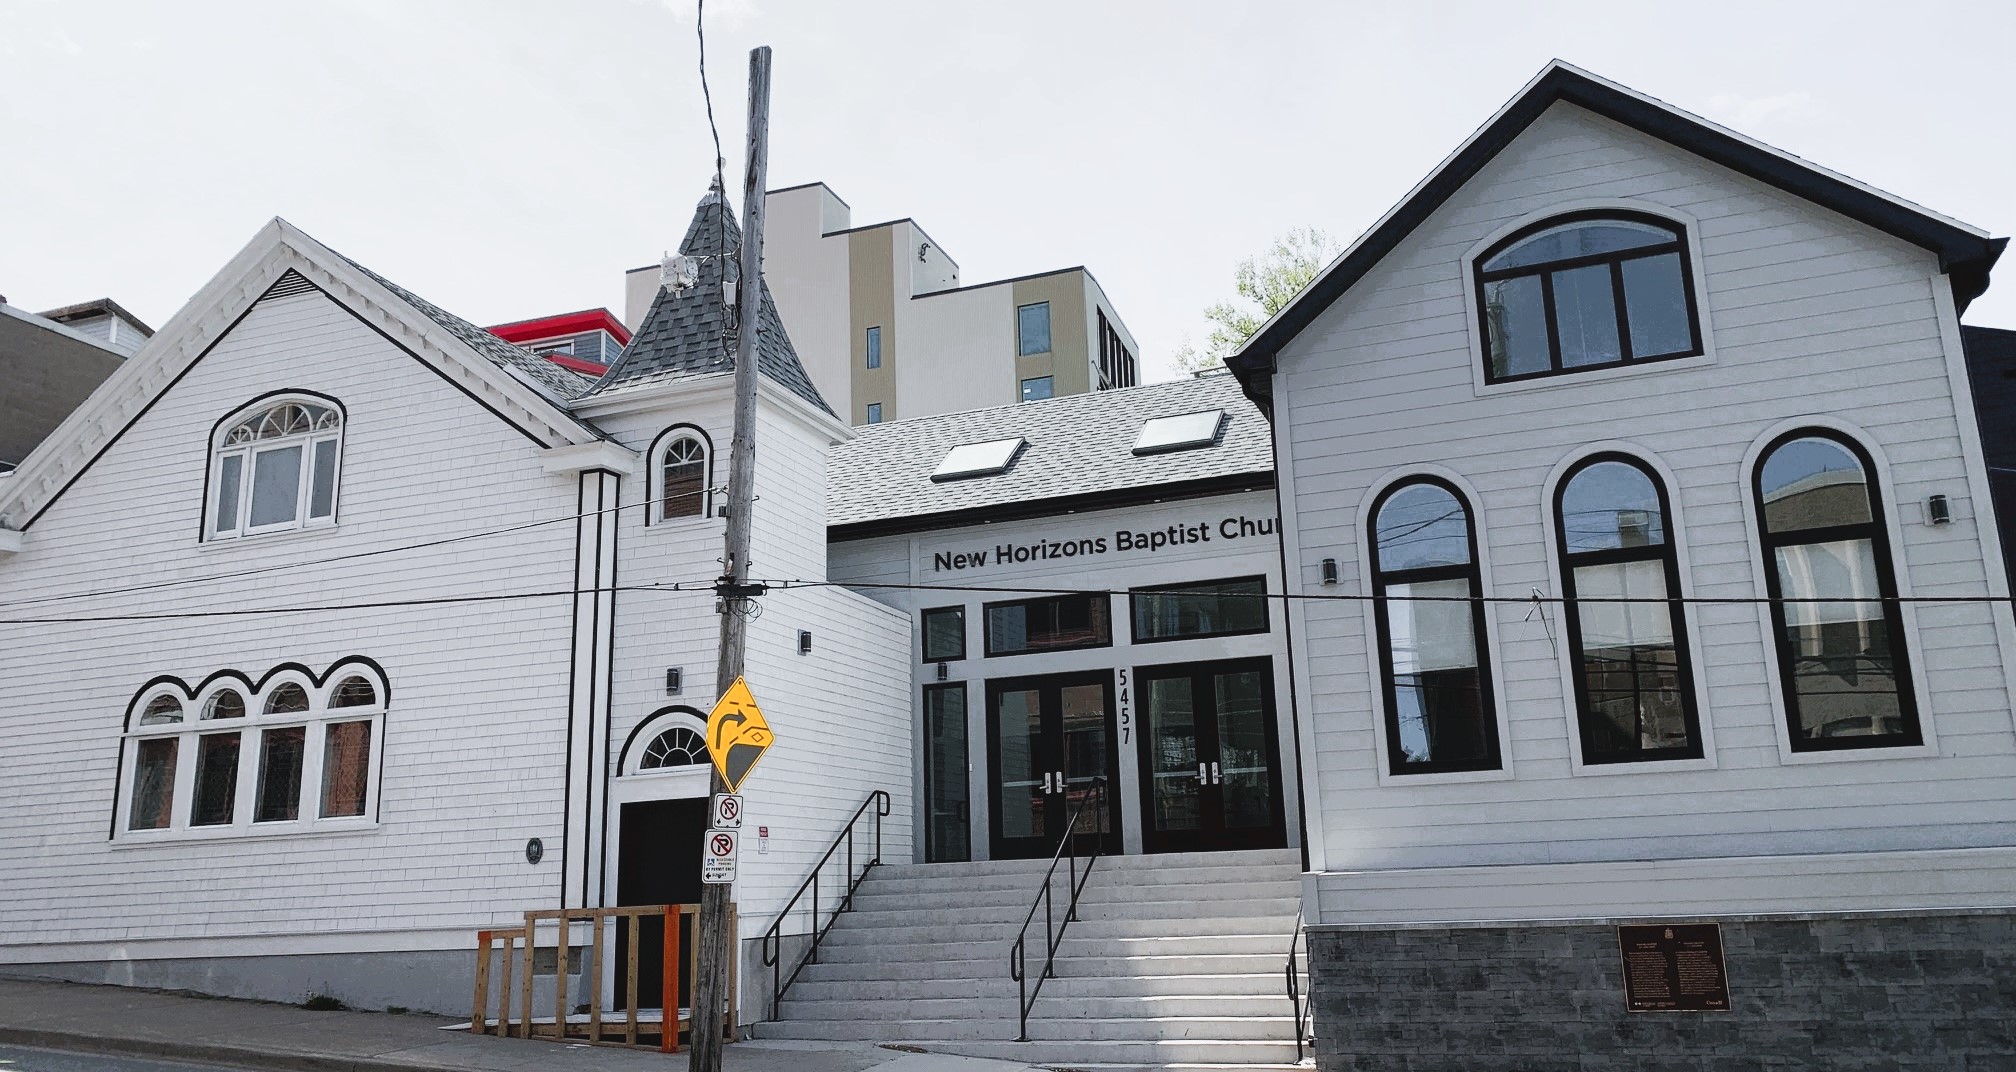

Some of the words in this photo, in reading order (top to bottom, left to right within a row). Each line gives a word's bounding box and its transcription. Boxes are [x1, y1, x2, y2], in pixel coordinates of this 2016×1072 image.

[934, 550, 987, 572] New
[996, 535, 1107, 565] Horizons
[1116, 521, 1211, 552] Baptist
[1119, 669, 1130, 745] 5457
